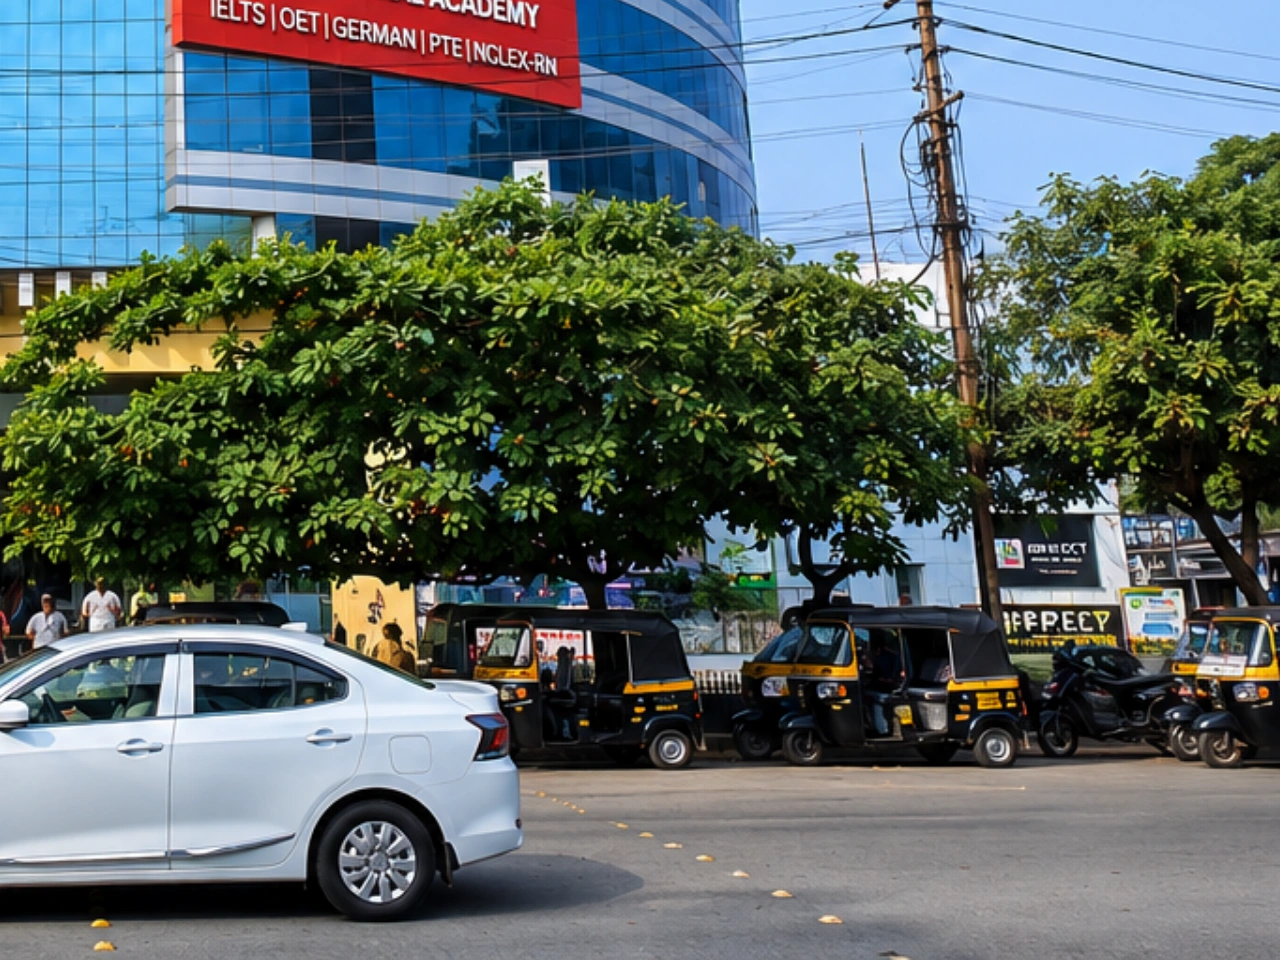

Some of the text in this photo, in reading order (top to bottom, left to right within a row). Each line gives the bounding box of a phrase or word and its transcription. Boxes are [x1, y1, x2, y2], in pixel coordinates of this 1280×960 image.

[279, 6, 320, 34] OET
[332, 16, 417, 50] GERMAN
[429, 32, 462, 58] PTE
